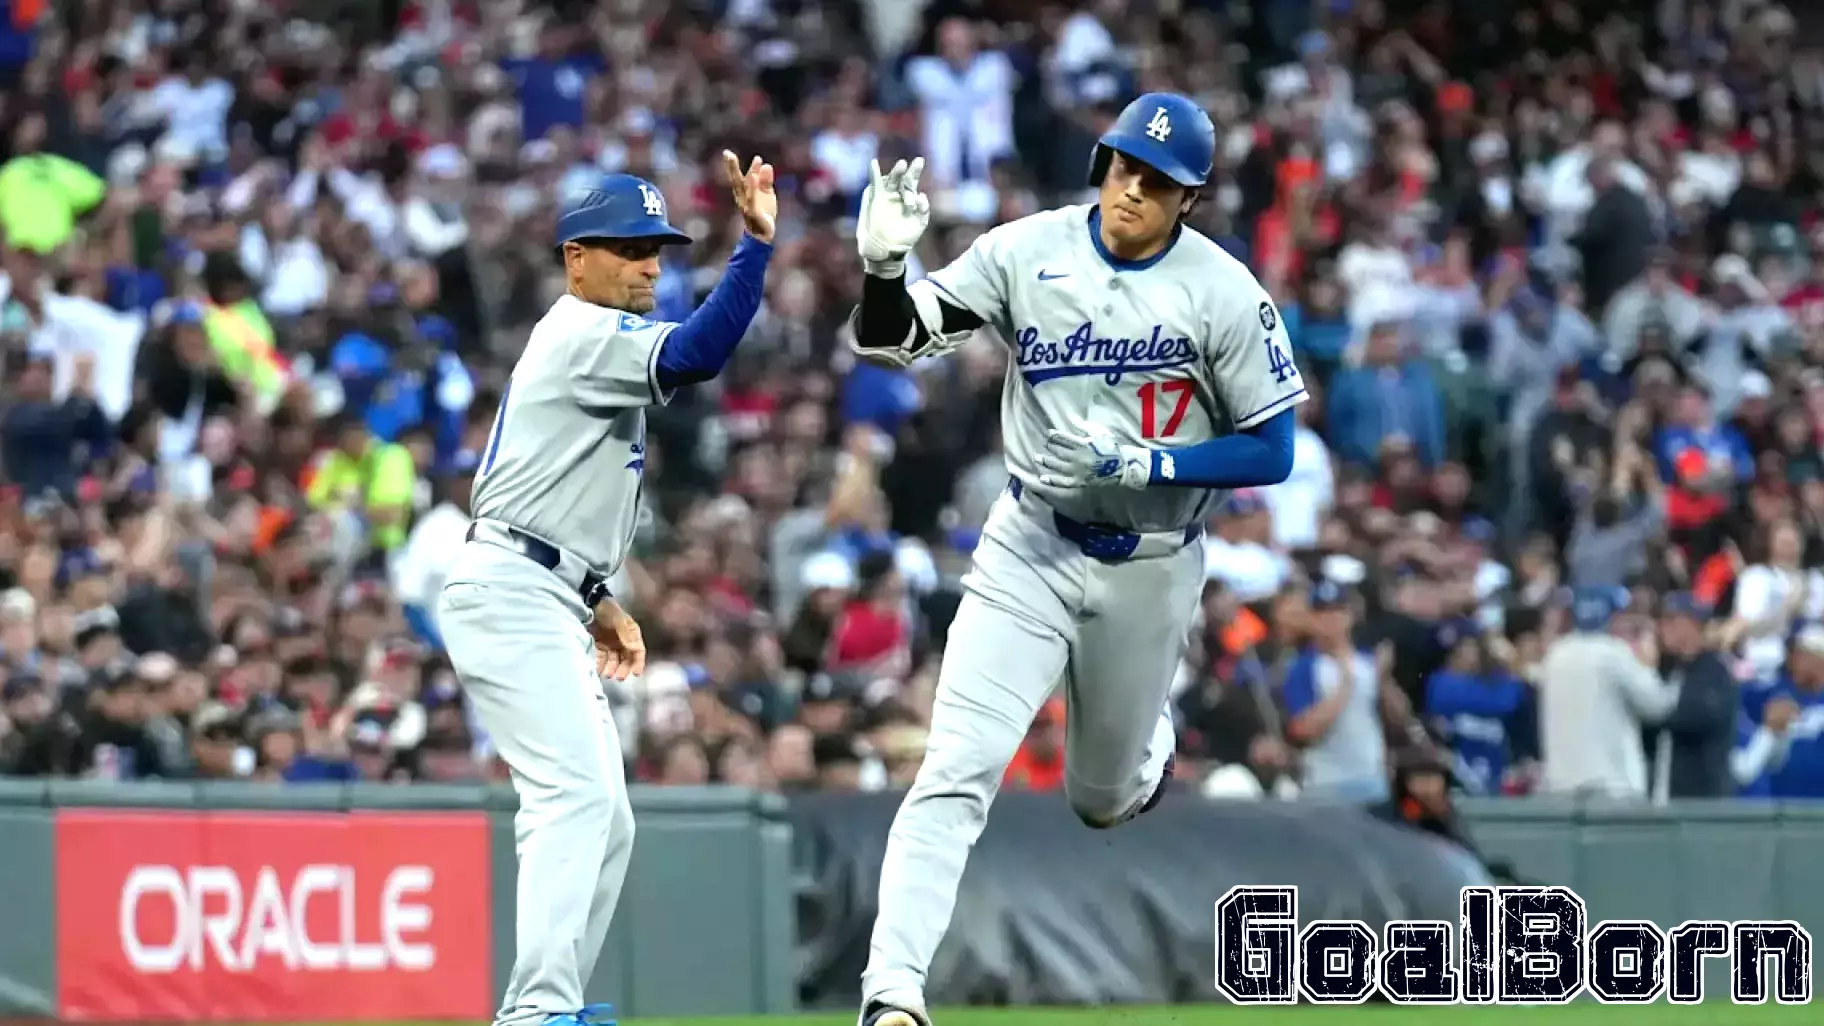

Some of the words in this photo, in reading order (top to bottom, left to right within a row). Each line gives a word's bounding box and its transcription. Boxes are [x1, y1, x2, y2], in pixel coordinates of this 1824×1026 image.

[1145, 106, 1171, 142] LA
[638, 185, 663, 216] LA
[1016, 326, 1060, 366] Los
[1060, 321, 1199, 386] Angeles
[1264, 337, 1297, 384] LA
[1136, 378, 1200, 439] 17
[120, 864, 437, 972] ORACLE
